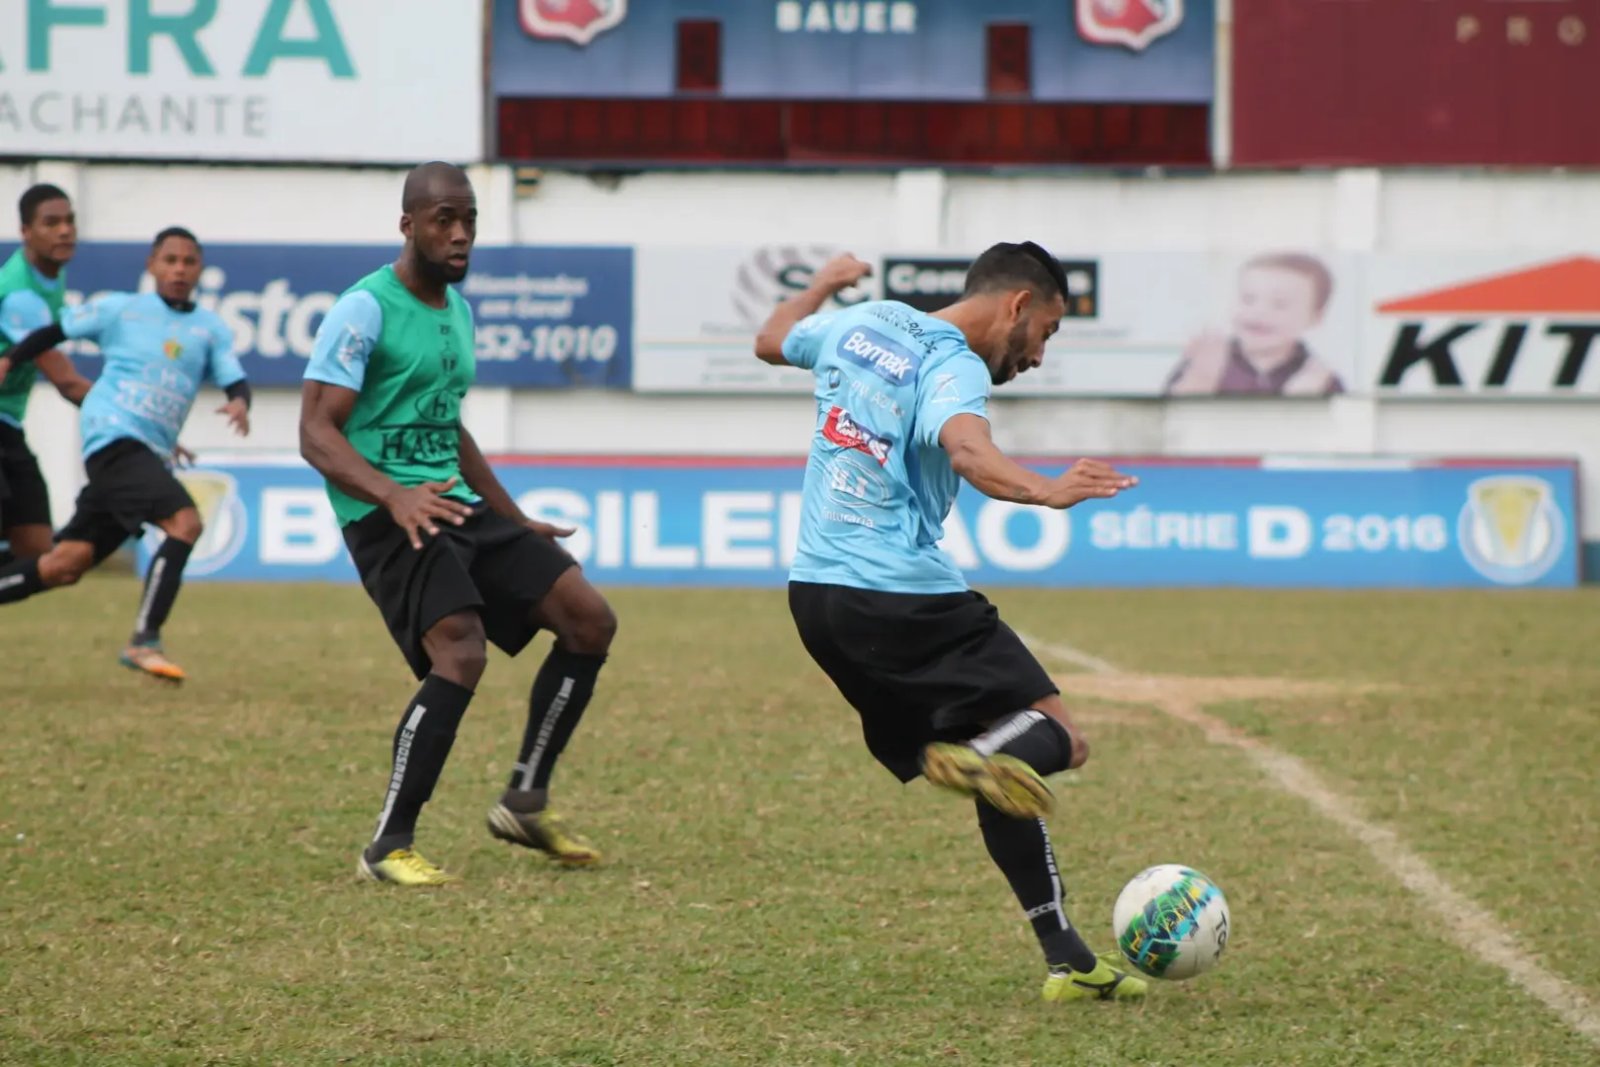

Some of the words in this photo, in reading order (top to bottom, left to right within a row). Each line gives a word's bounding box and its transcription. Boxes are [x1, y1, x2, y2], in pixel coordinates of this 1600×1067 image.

[0, 0, 359, 80] FRA
[776, 1, 917, 34] BAUER
[1379, 320, 1600, 388] KIT
[1089, 504, 1238, 551] SÉRIE
[1247, 505, 1312, 559] D
[1322, 513, 1448, 552] 2016
